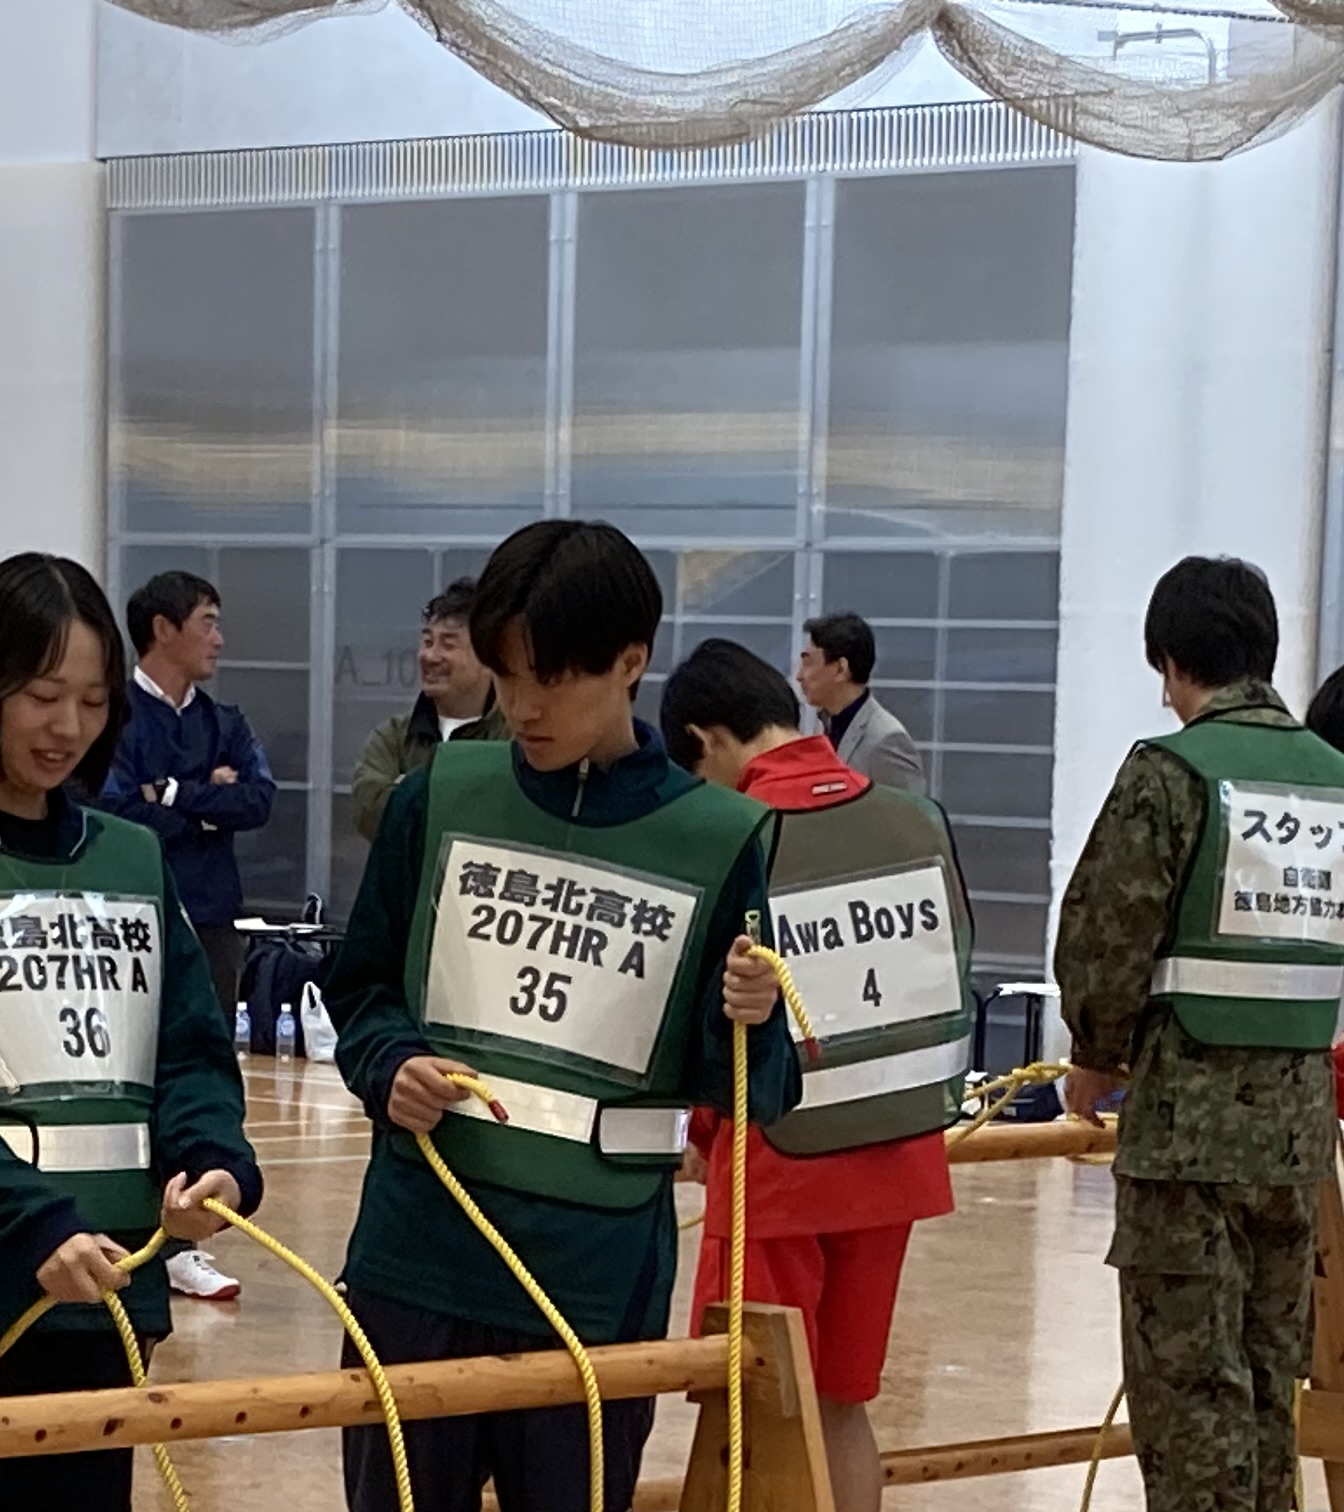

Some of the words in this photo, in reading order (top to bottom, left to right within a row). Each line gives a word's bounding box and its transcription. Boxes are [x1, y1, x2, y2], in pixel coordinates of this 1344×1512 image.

[457, 860, 676, 942] 徳島北高校
[777, 913, 844, 958] Awa
[847, 898, 940, 945] Boys
[468, 904, 608, 967] 207HR
[617, 940, 647, 979] A
[131, 956, 149, 994] A
[509, 965, 573, 1023] 35
[862, 968, 882, 1007] 4
[59, 1006, 111, 1058] 36
